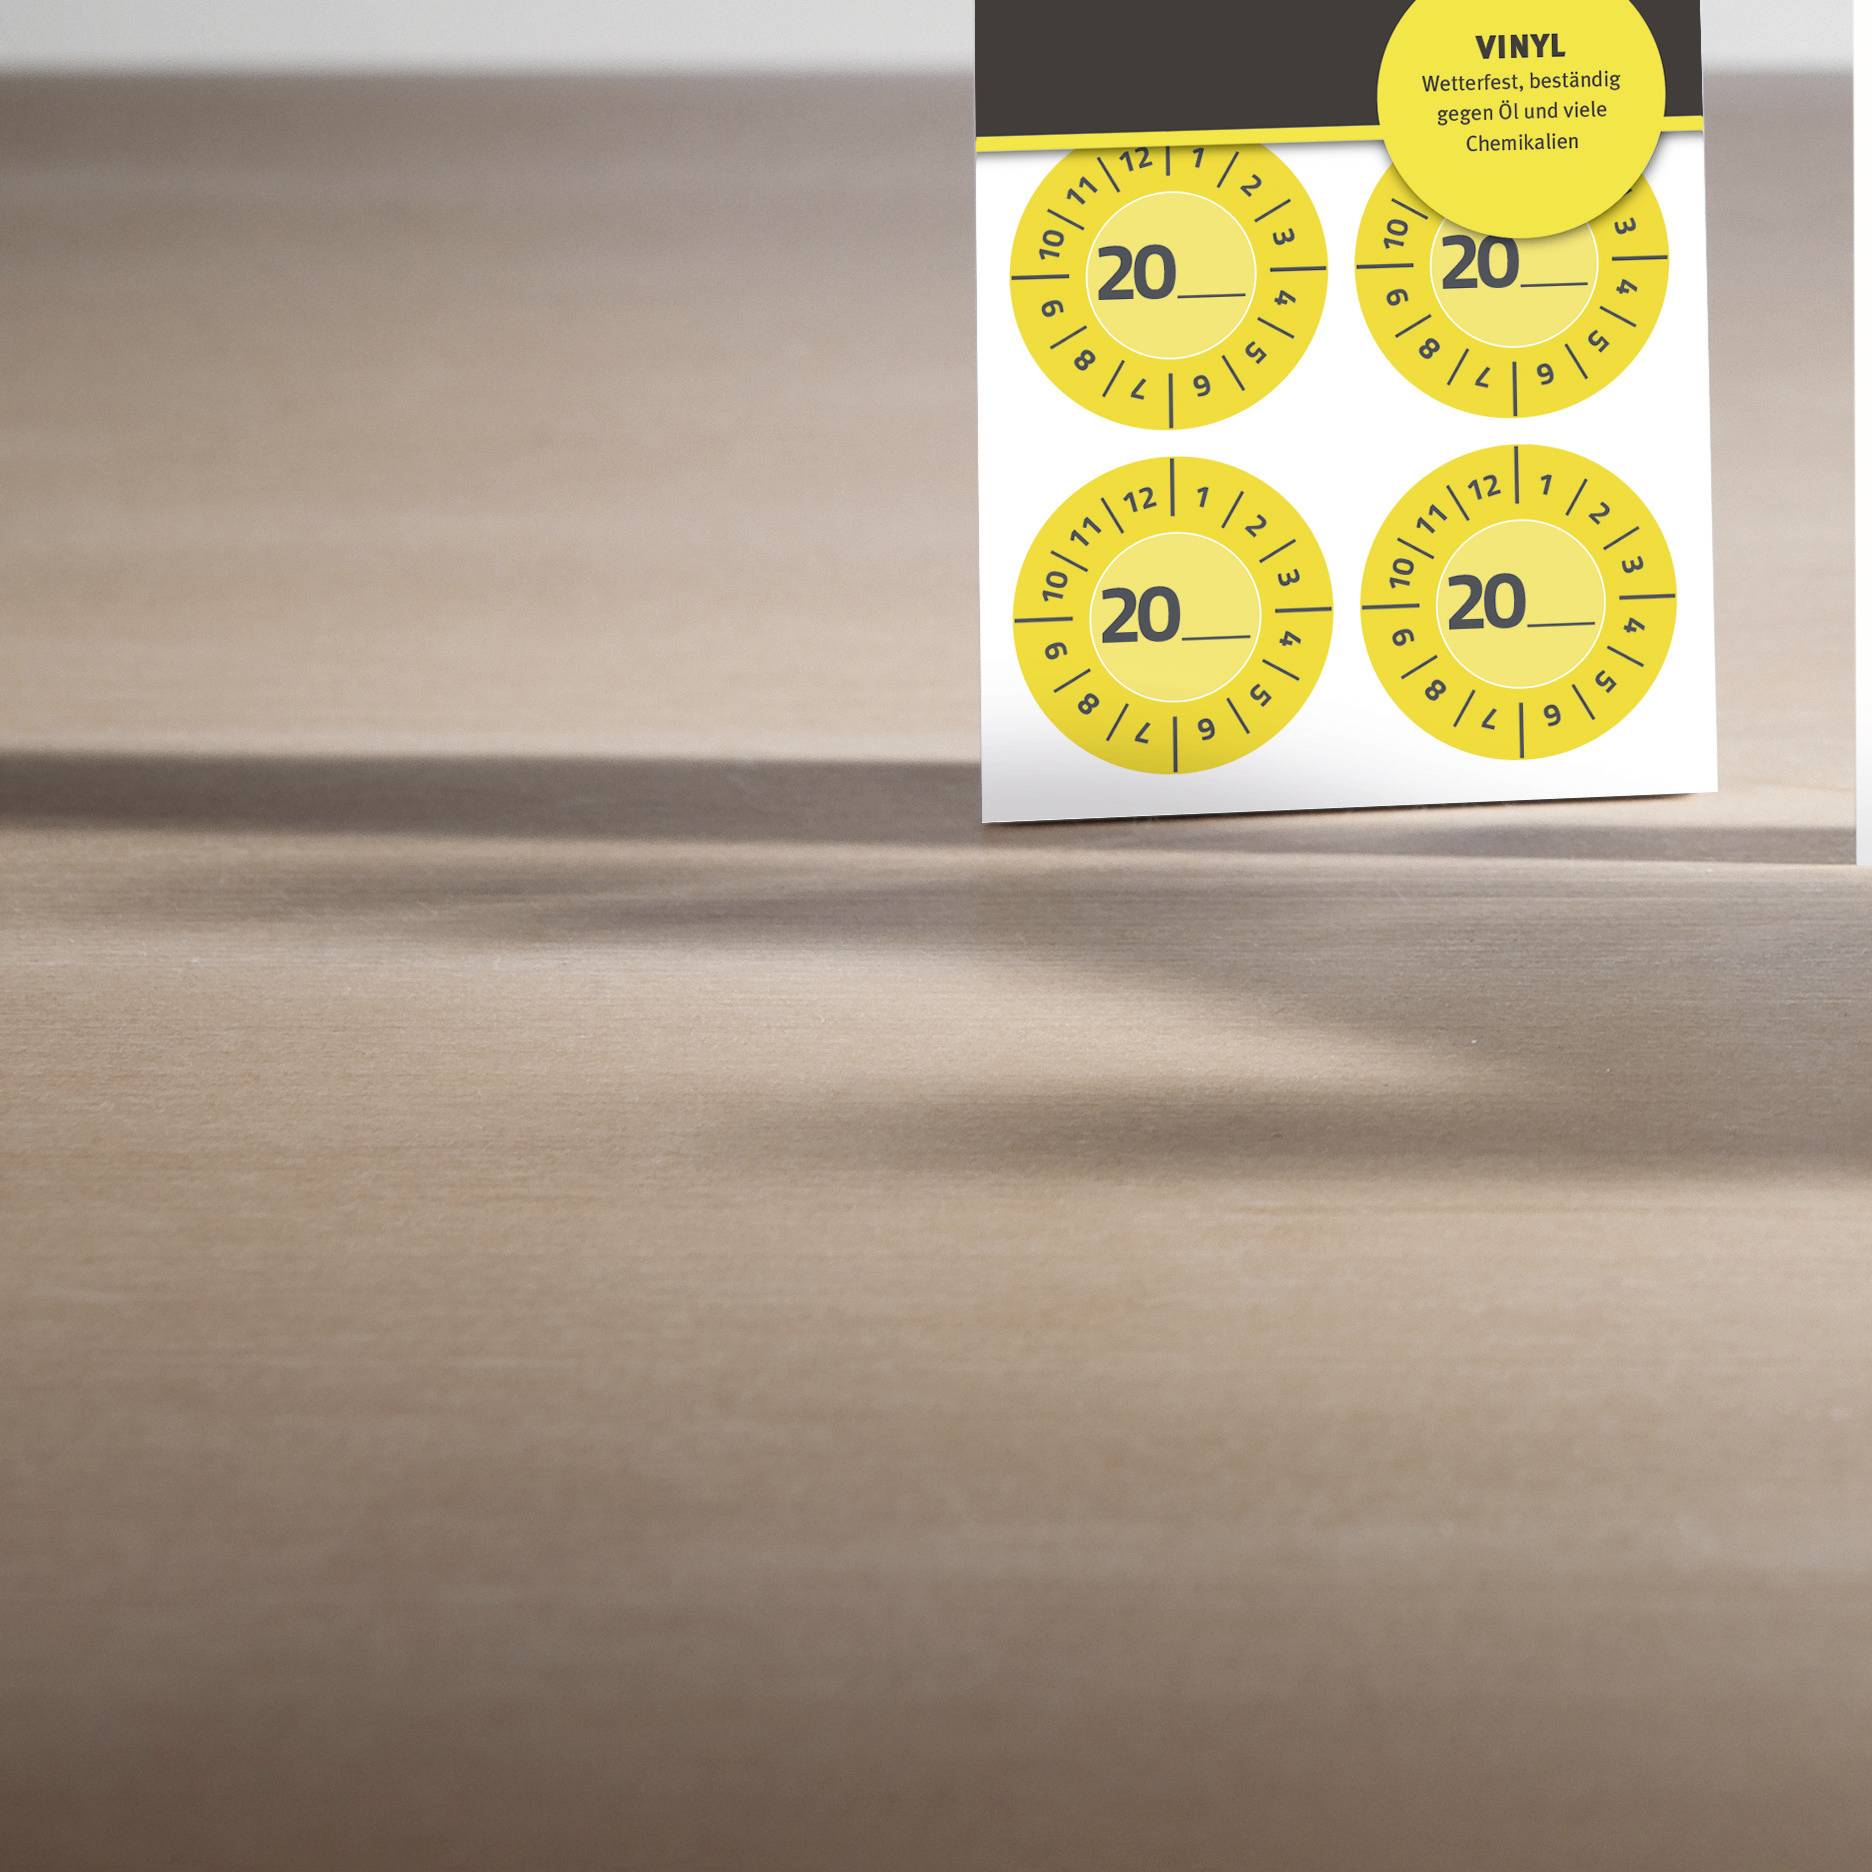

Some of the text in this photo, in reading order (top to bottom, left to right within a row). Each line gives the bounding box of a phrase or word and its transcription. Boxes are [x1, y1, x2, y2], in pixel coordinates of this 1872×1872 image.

[1475, 32, 1567, 61] VINYL
[1421, 68, 1621, 93] Wetterfest, beständig
[1437, 98, 1608, 126] gegen Öl und viele
[1465, 131, 1580, 153] Chemikalien
[1042, 486, 1301, 744] 1 2 3 4 5 6 7 8 9 10 11 12
